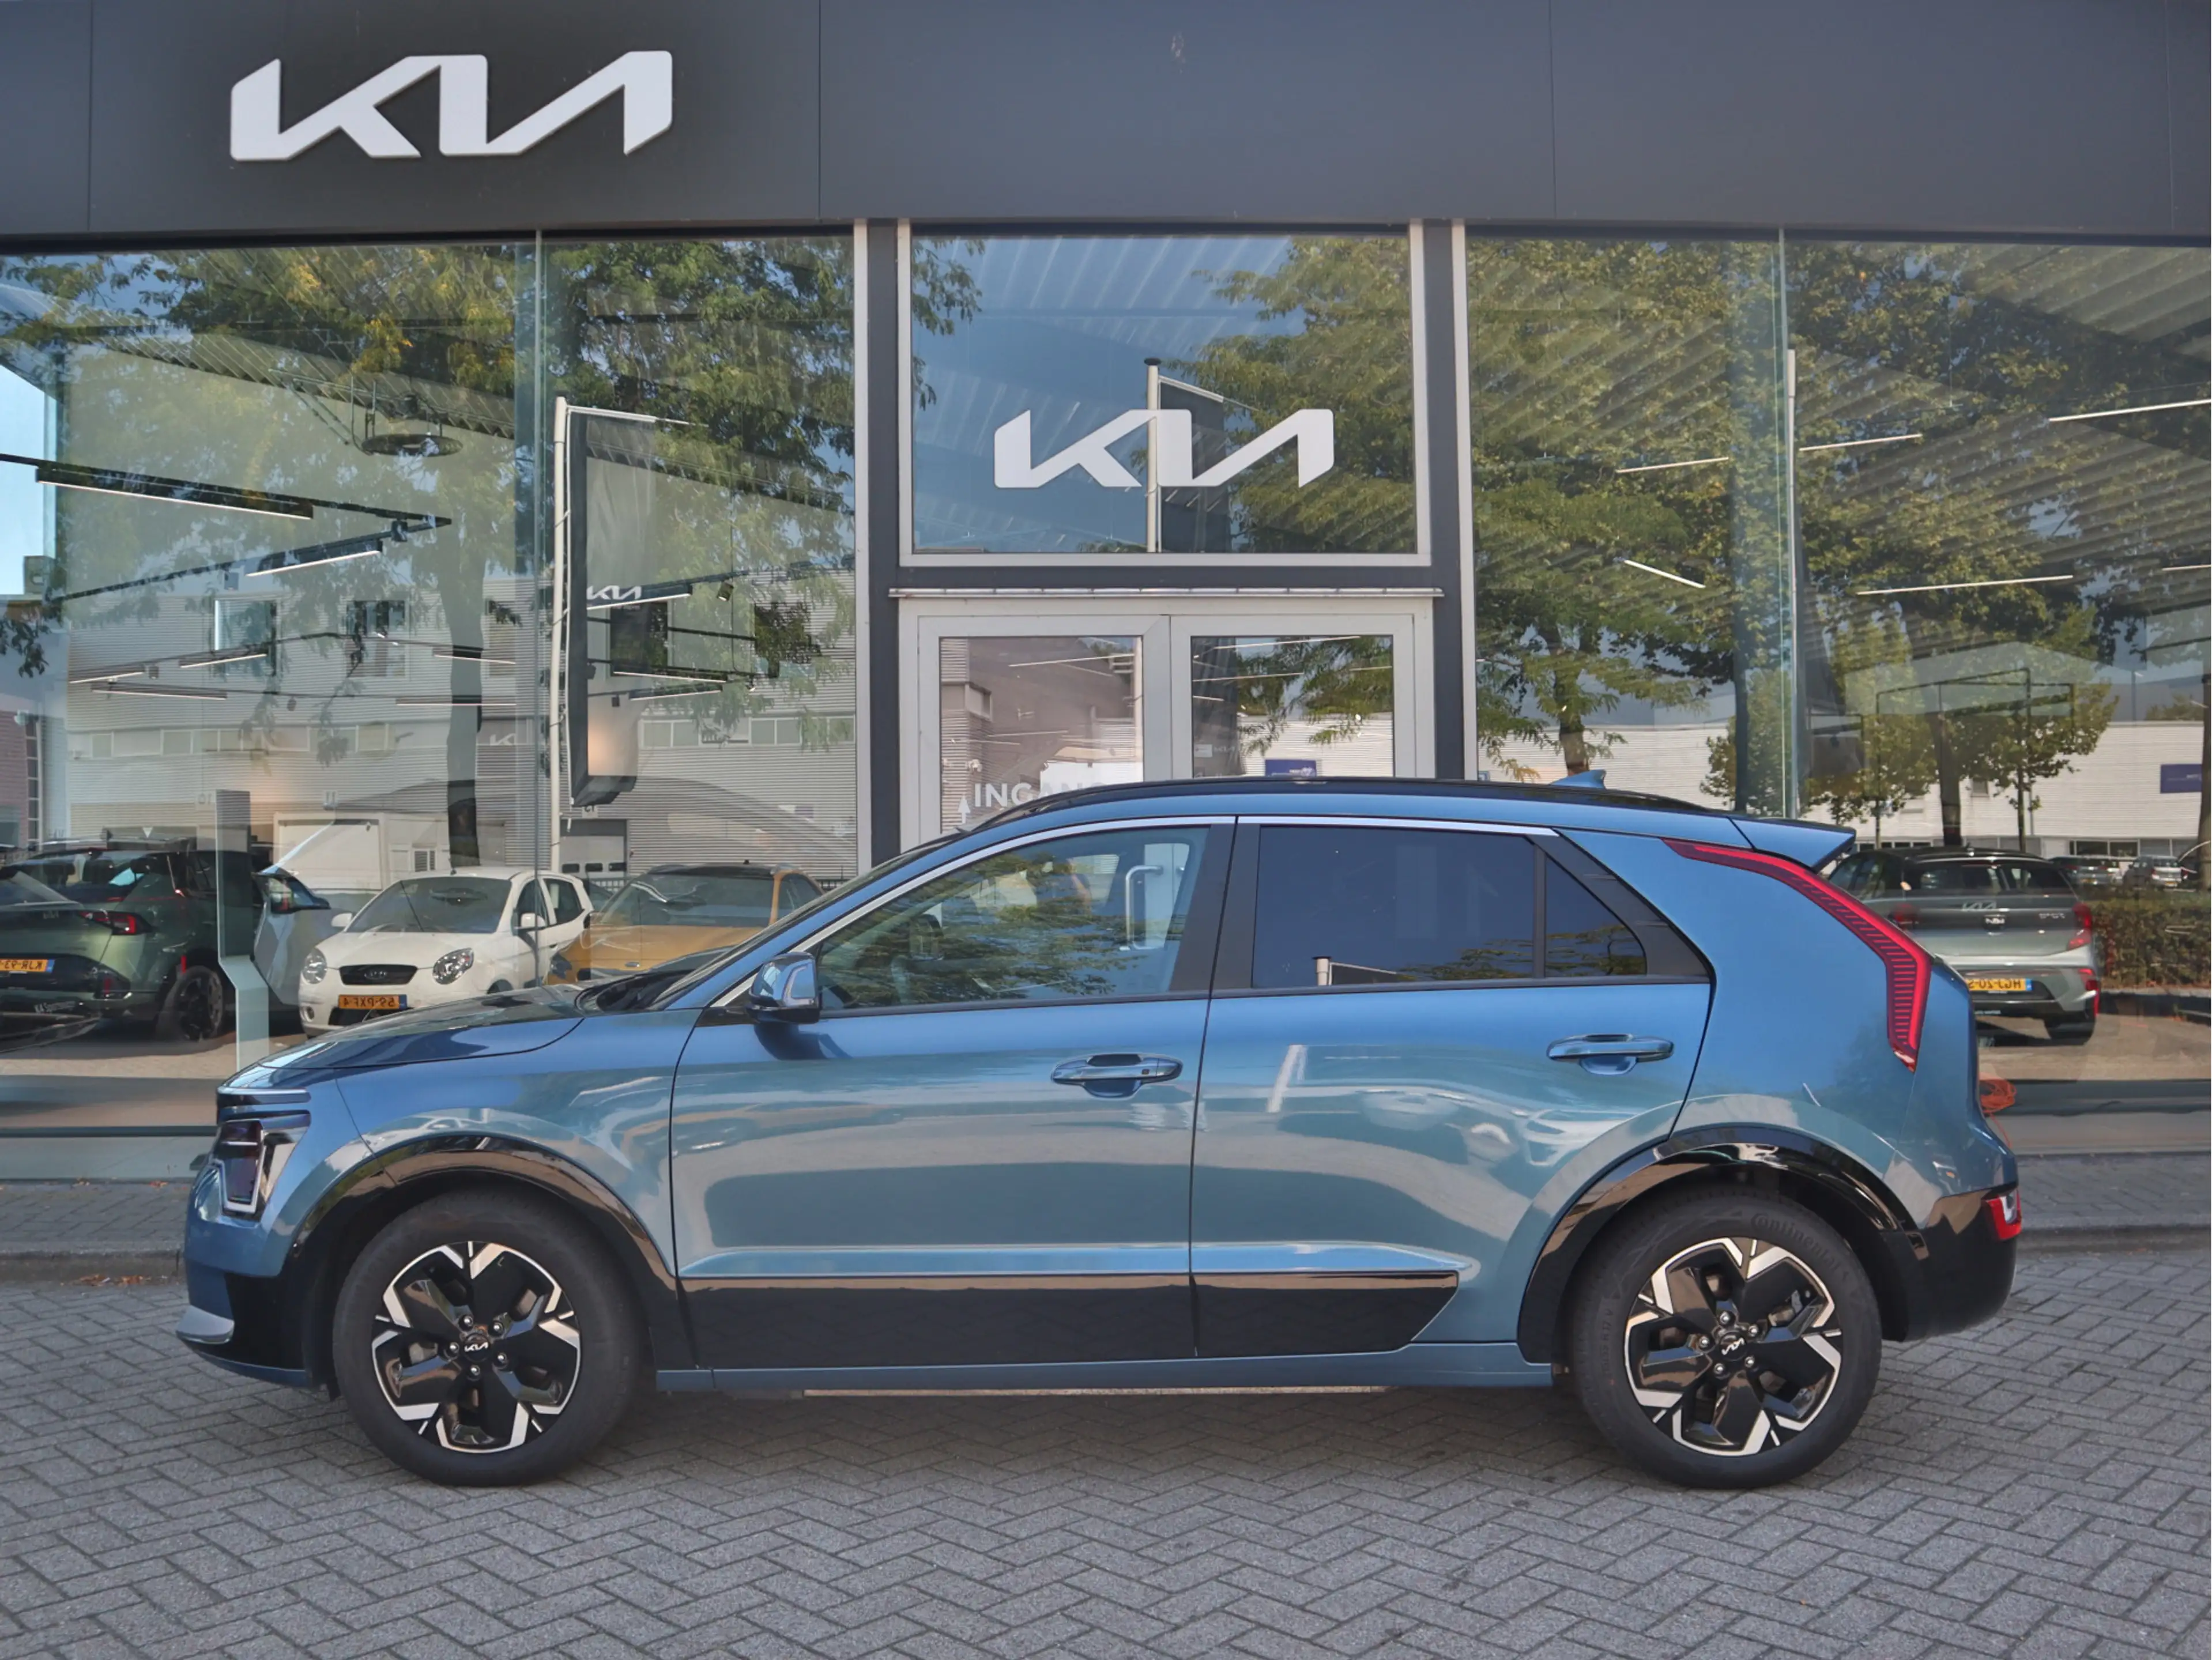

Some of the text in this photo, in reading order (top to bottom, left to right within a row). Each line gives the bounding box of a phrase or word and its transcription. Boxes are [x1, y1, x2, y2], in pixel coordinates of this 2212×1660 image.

[230, 50, 673, 161] KIA
[994, 409, 1335, 488] KIA
[586, 585, 642, 601] KIA
[974, 782, 1106, 808] INGA
[464, 1341, 489, 1352] KIA
